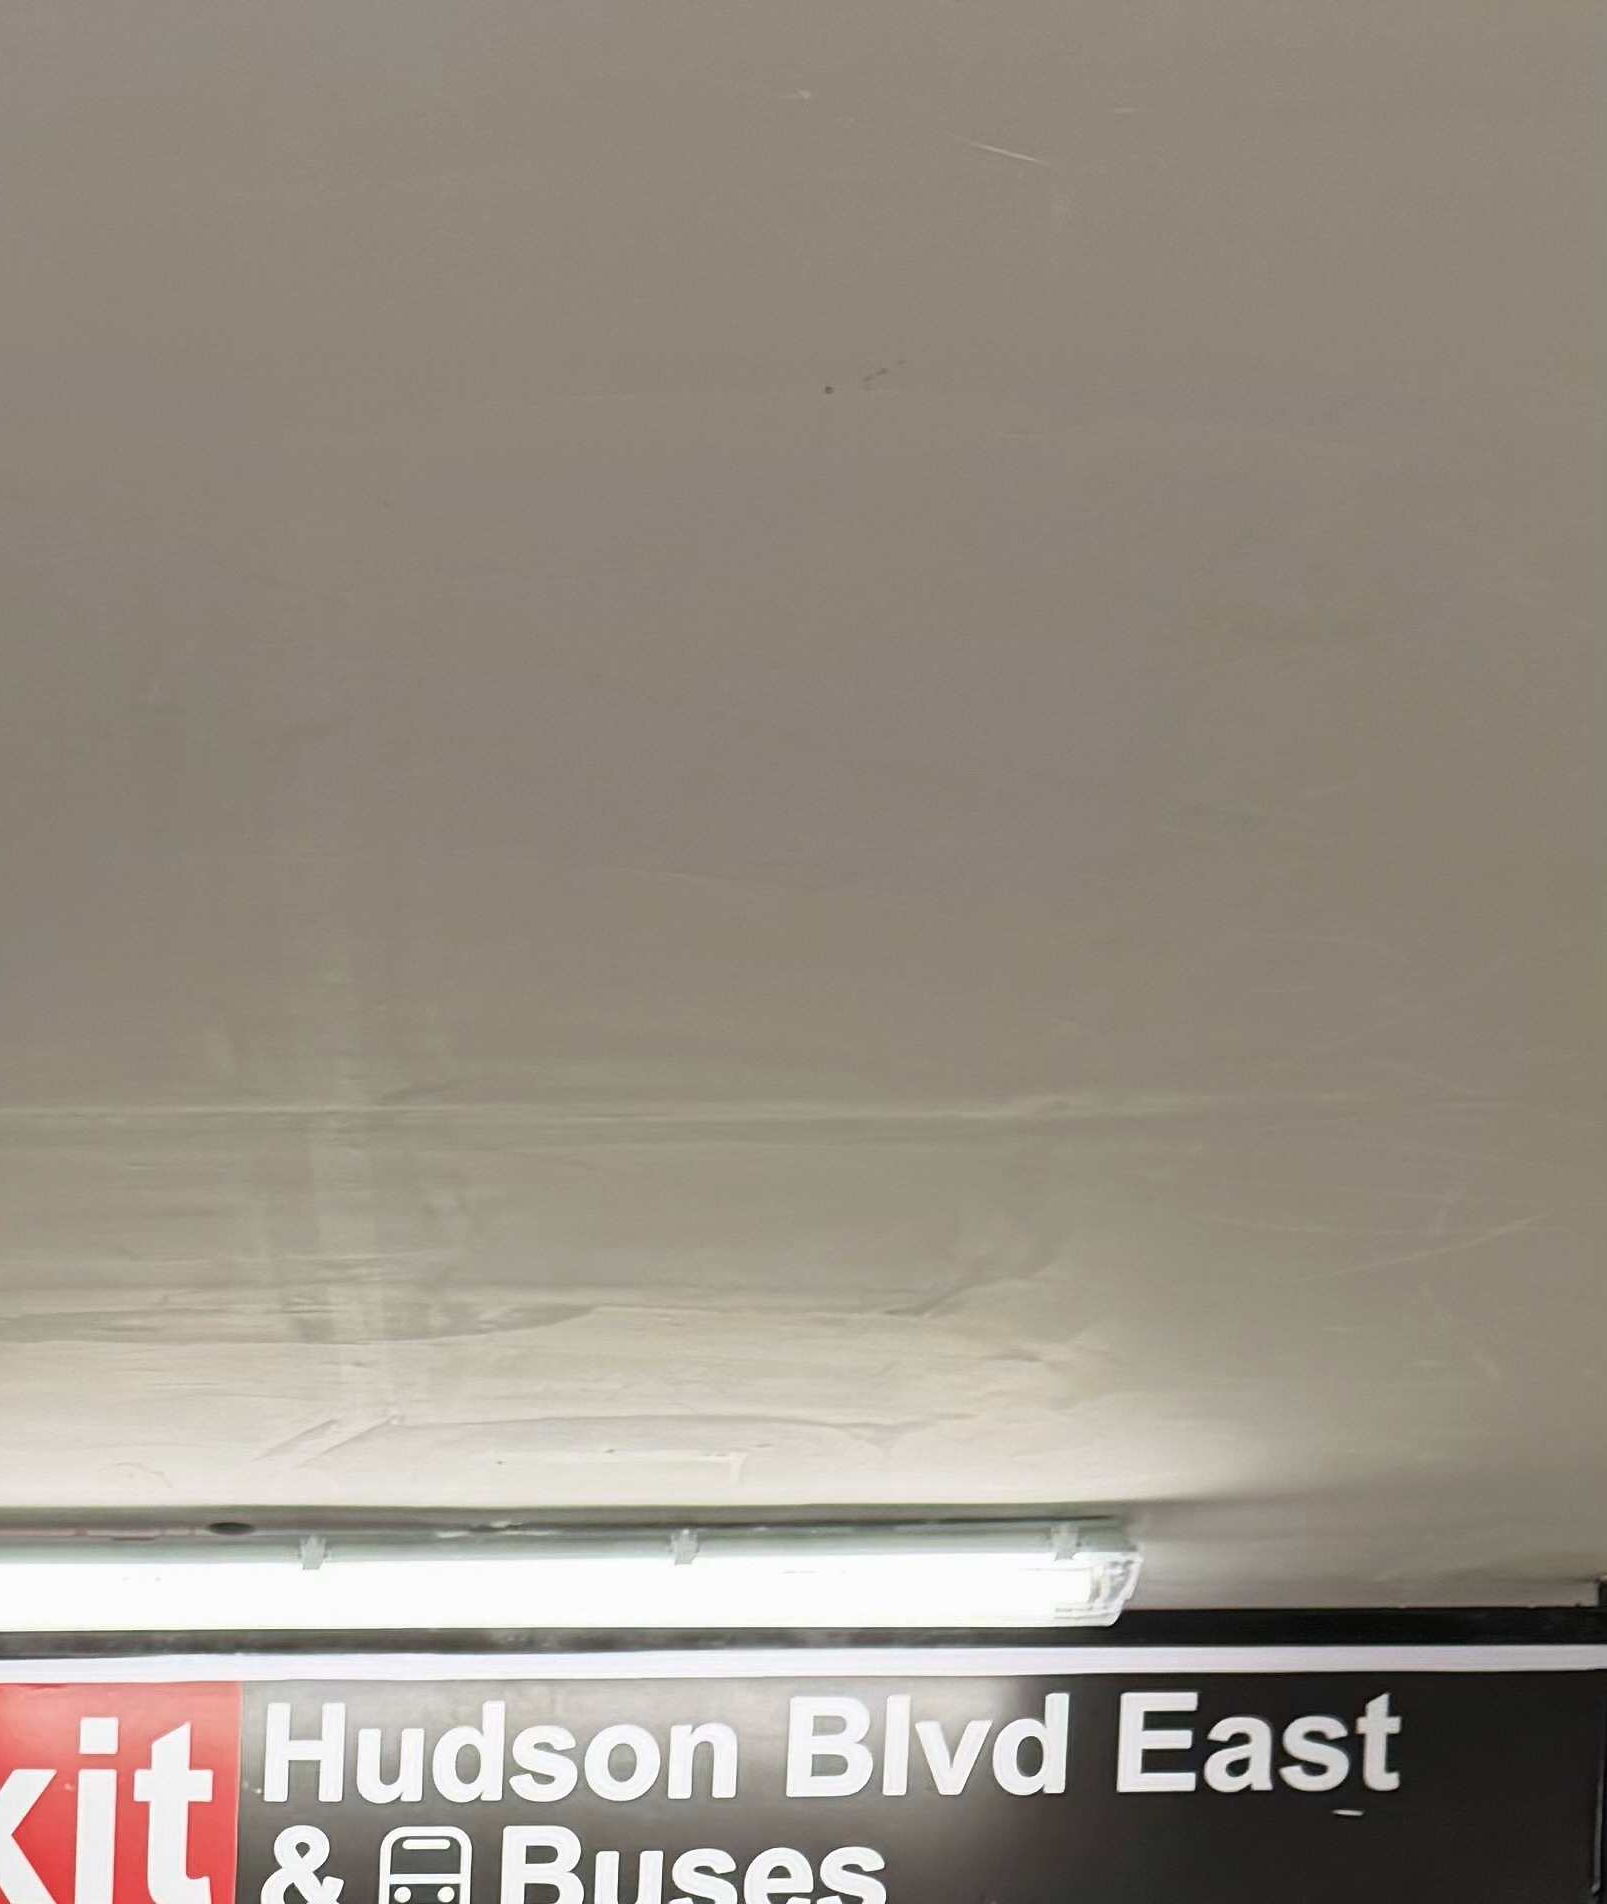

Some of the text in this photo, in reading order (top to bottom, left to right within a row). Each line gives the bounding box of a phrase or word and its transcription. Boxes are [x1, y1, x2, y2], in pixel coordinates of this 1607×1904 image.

[263, 1691, 1402, 1804] Hudson Blvd East
